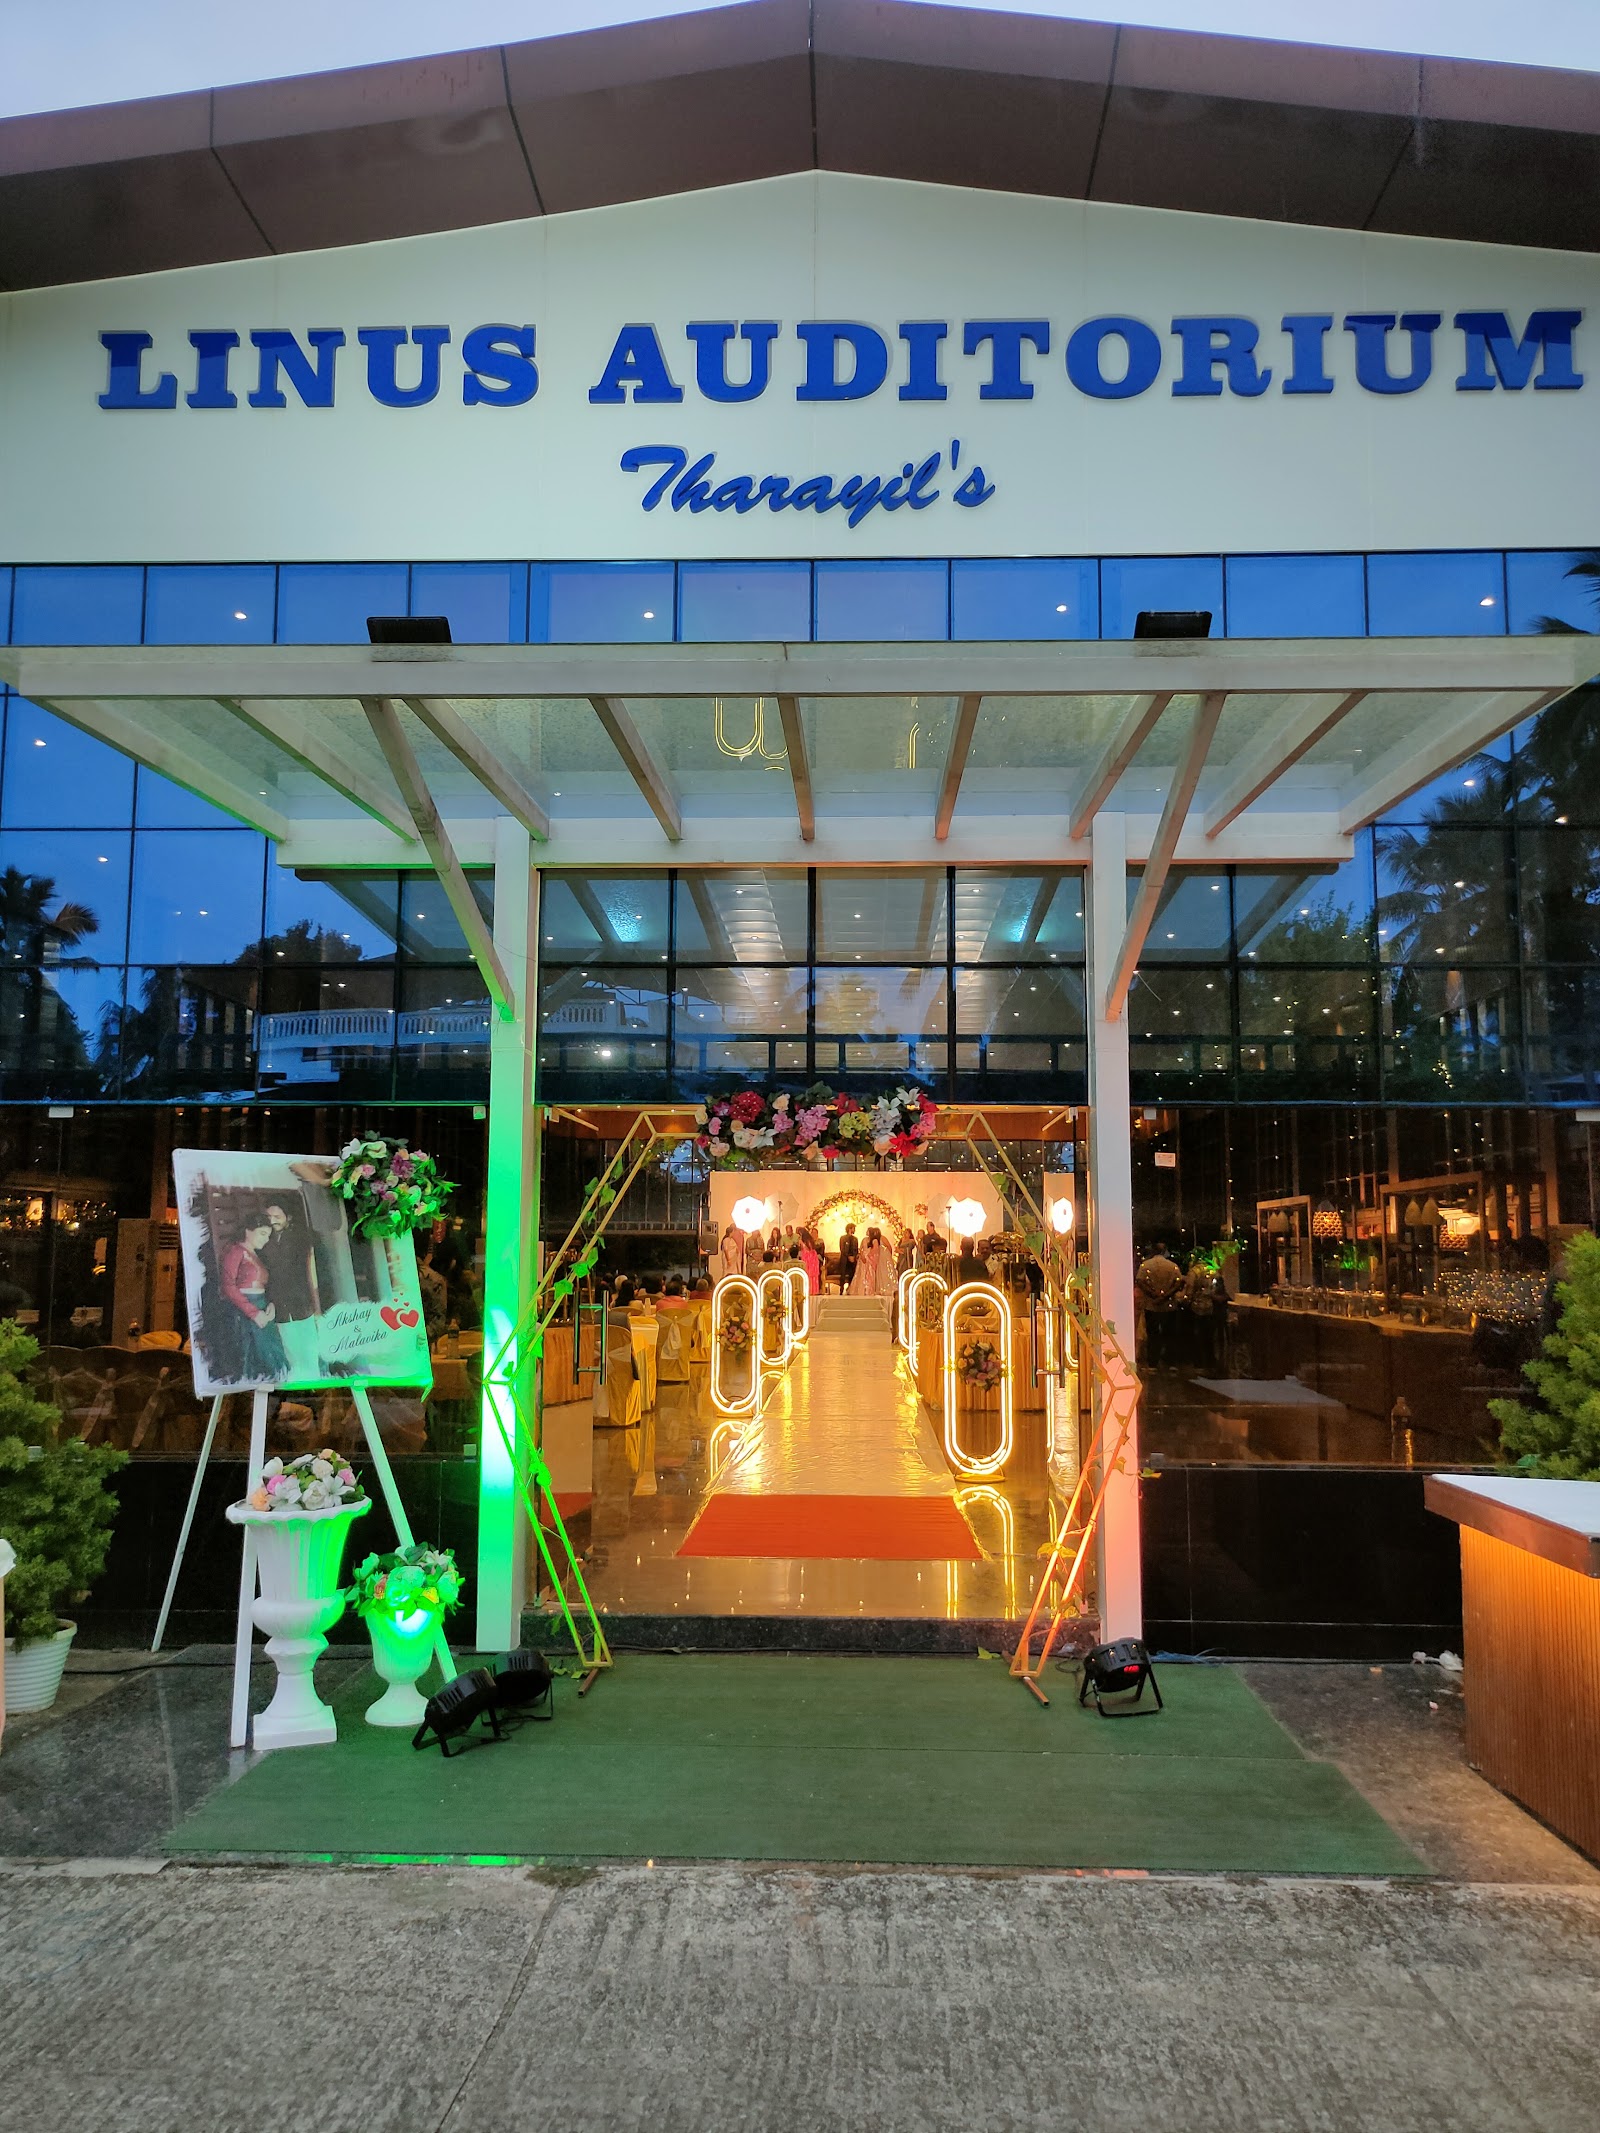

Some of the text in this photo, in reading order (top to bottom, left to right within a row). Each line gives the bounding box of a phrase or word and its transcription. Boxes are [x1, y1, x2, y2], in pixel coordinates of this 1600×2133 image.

[98, 310, 1584, 409] LINUS AUDITORIUM
[620, 439, 996, 528] Tharayil's
[327, 1308, 372, 1330] Akshay
[353, 1325, 362, 1333] &
[329, 1329, 388, 1354] Malavika
